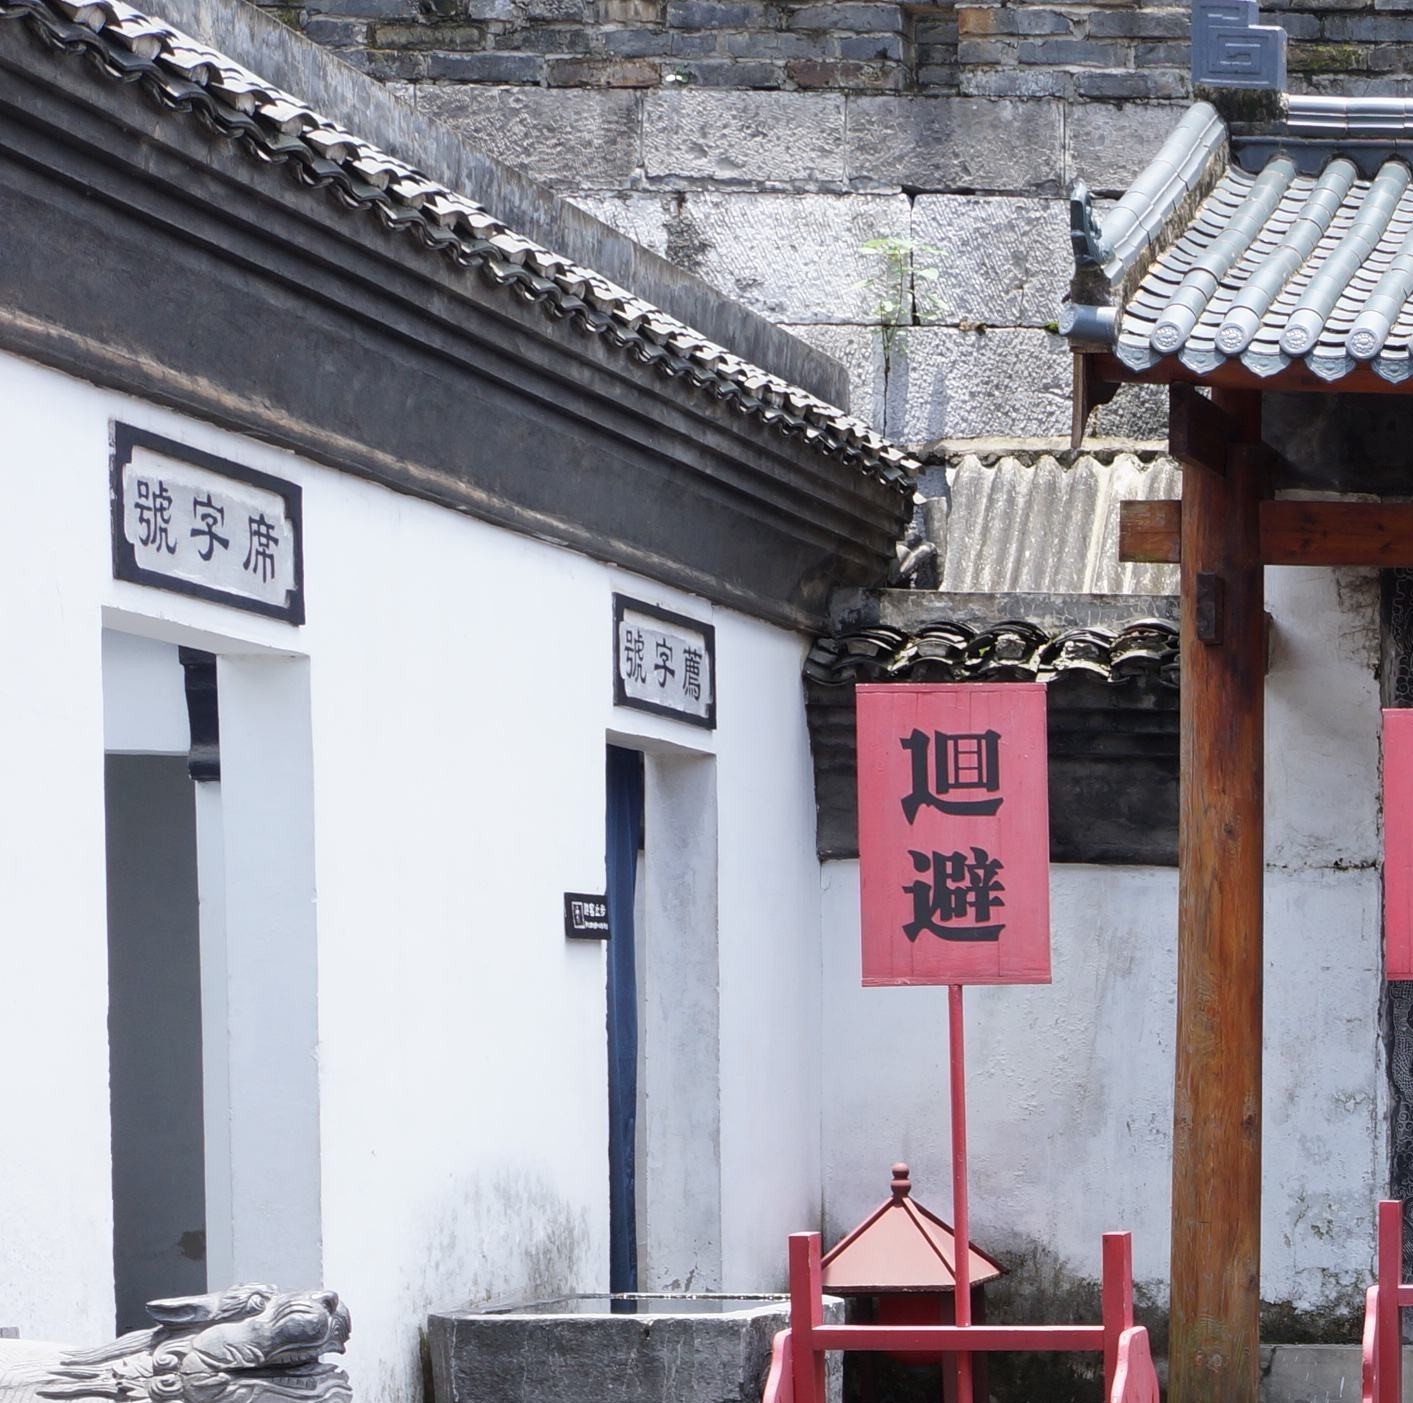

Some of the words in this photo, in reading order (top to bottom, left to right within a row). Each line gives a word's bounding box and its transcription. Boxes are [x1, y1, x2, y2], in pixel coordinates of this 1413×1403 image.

[134, 480, 279, 583] 席字號
[624, 627, 703, 702] 薦字號
[899, 728, 1006, 942] 迴避
